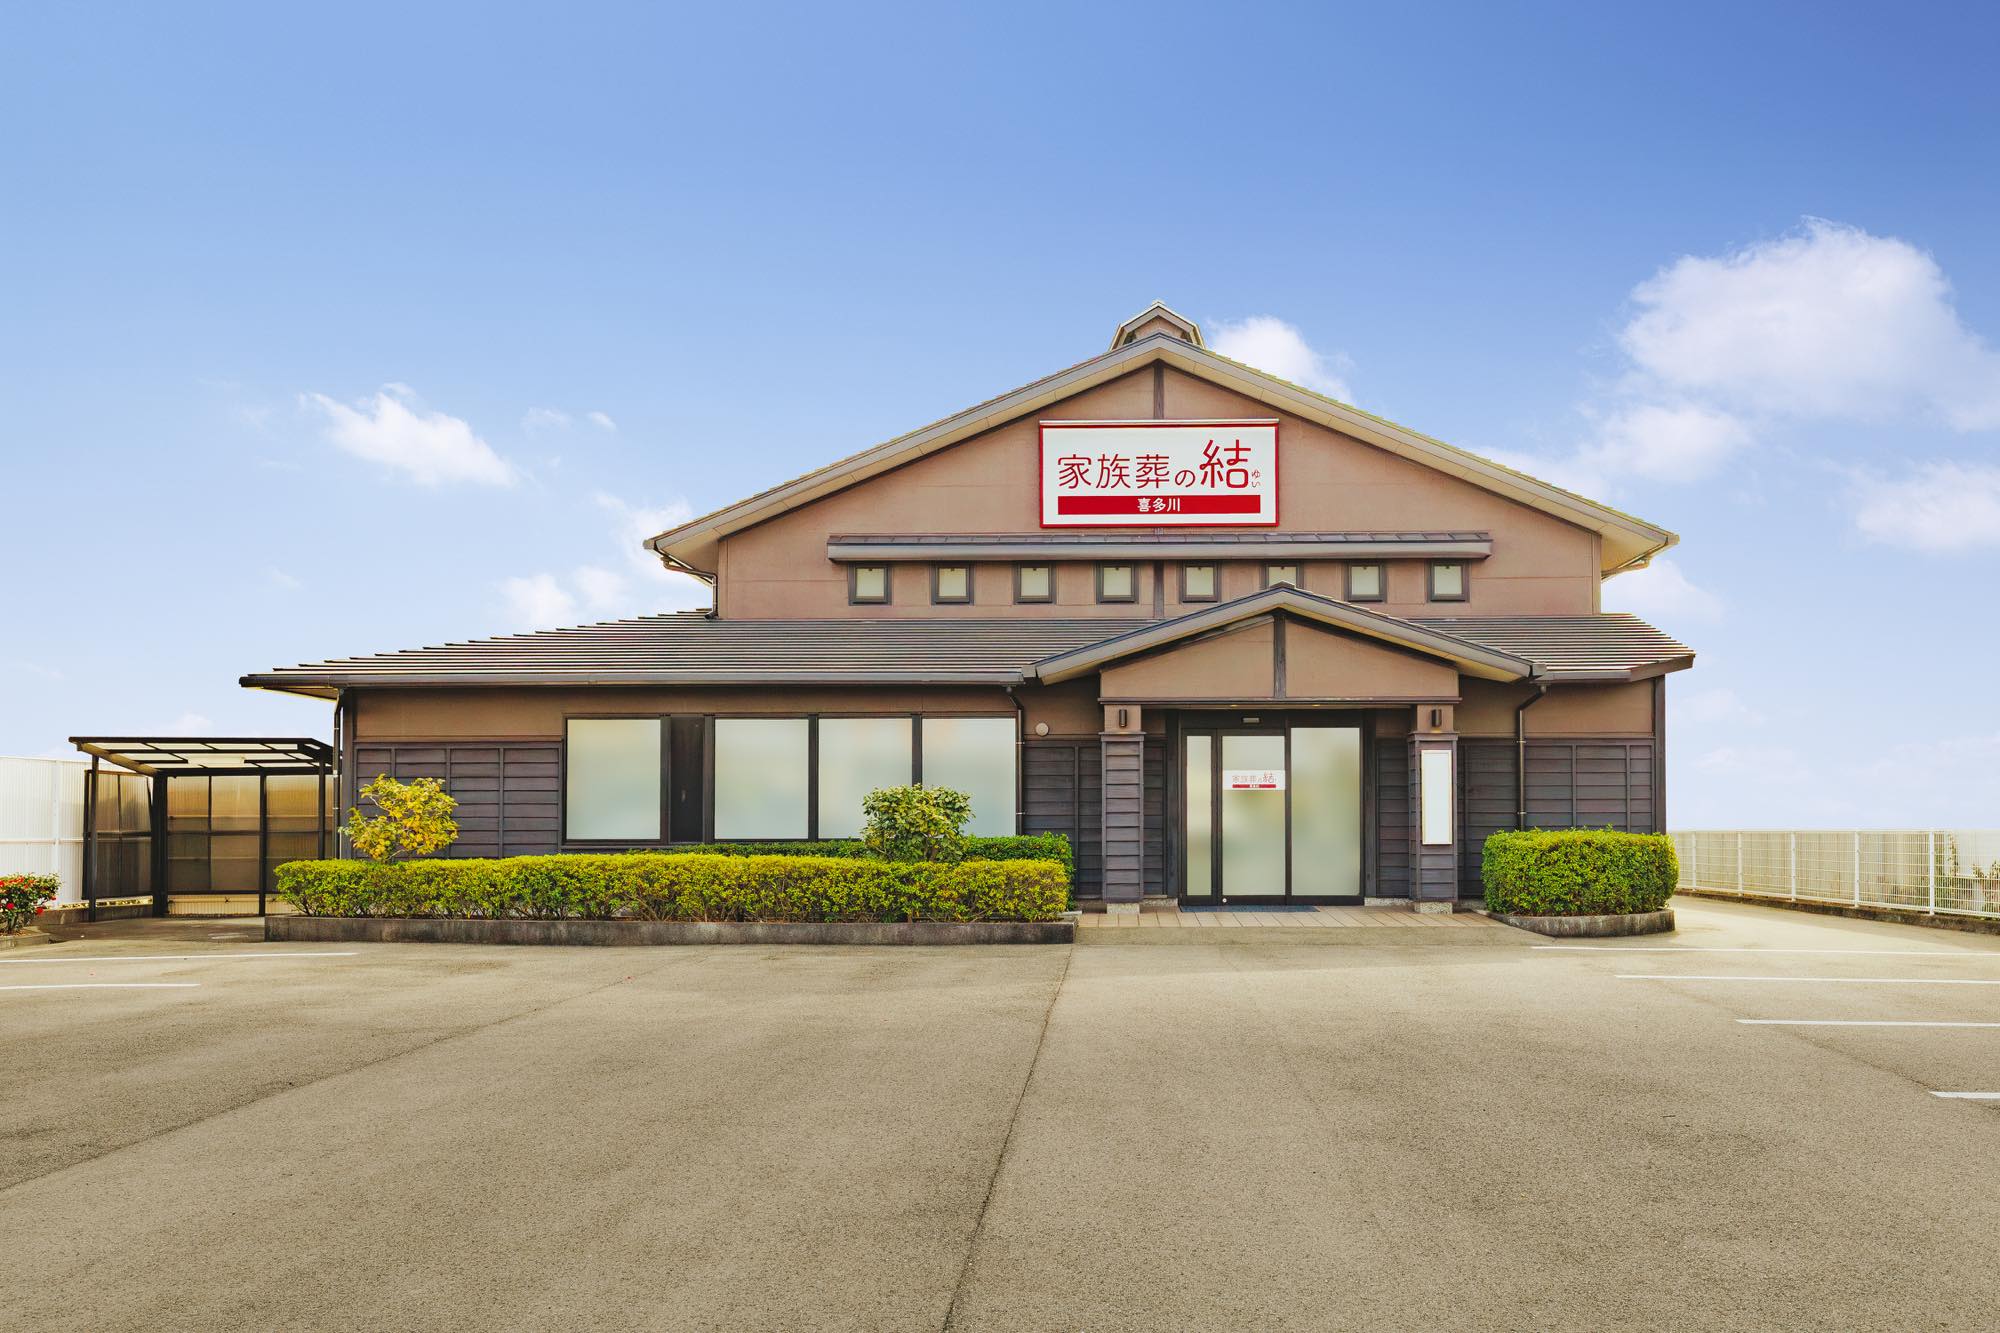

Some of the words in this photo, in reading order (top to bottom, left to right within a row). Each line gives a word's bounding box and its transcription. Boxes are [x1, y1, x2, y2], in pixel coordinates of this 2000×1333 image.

[1057, 439, 1252, 489] 家族葬の結
[1137, 497, 1181, 512] 喜多川
